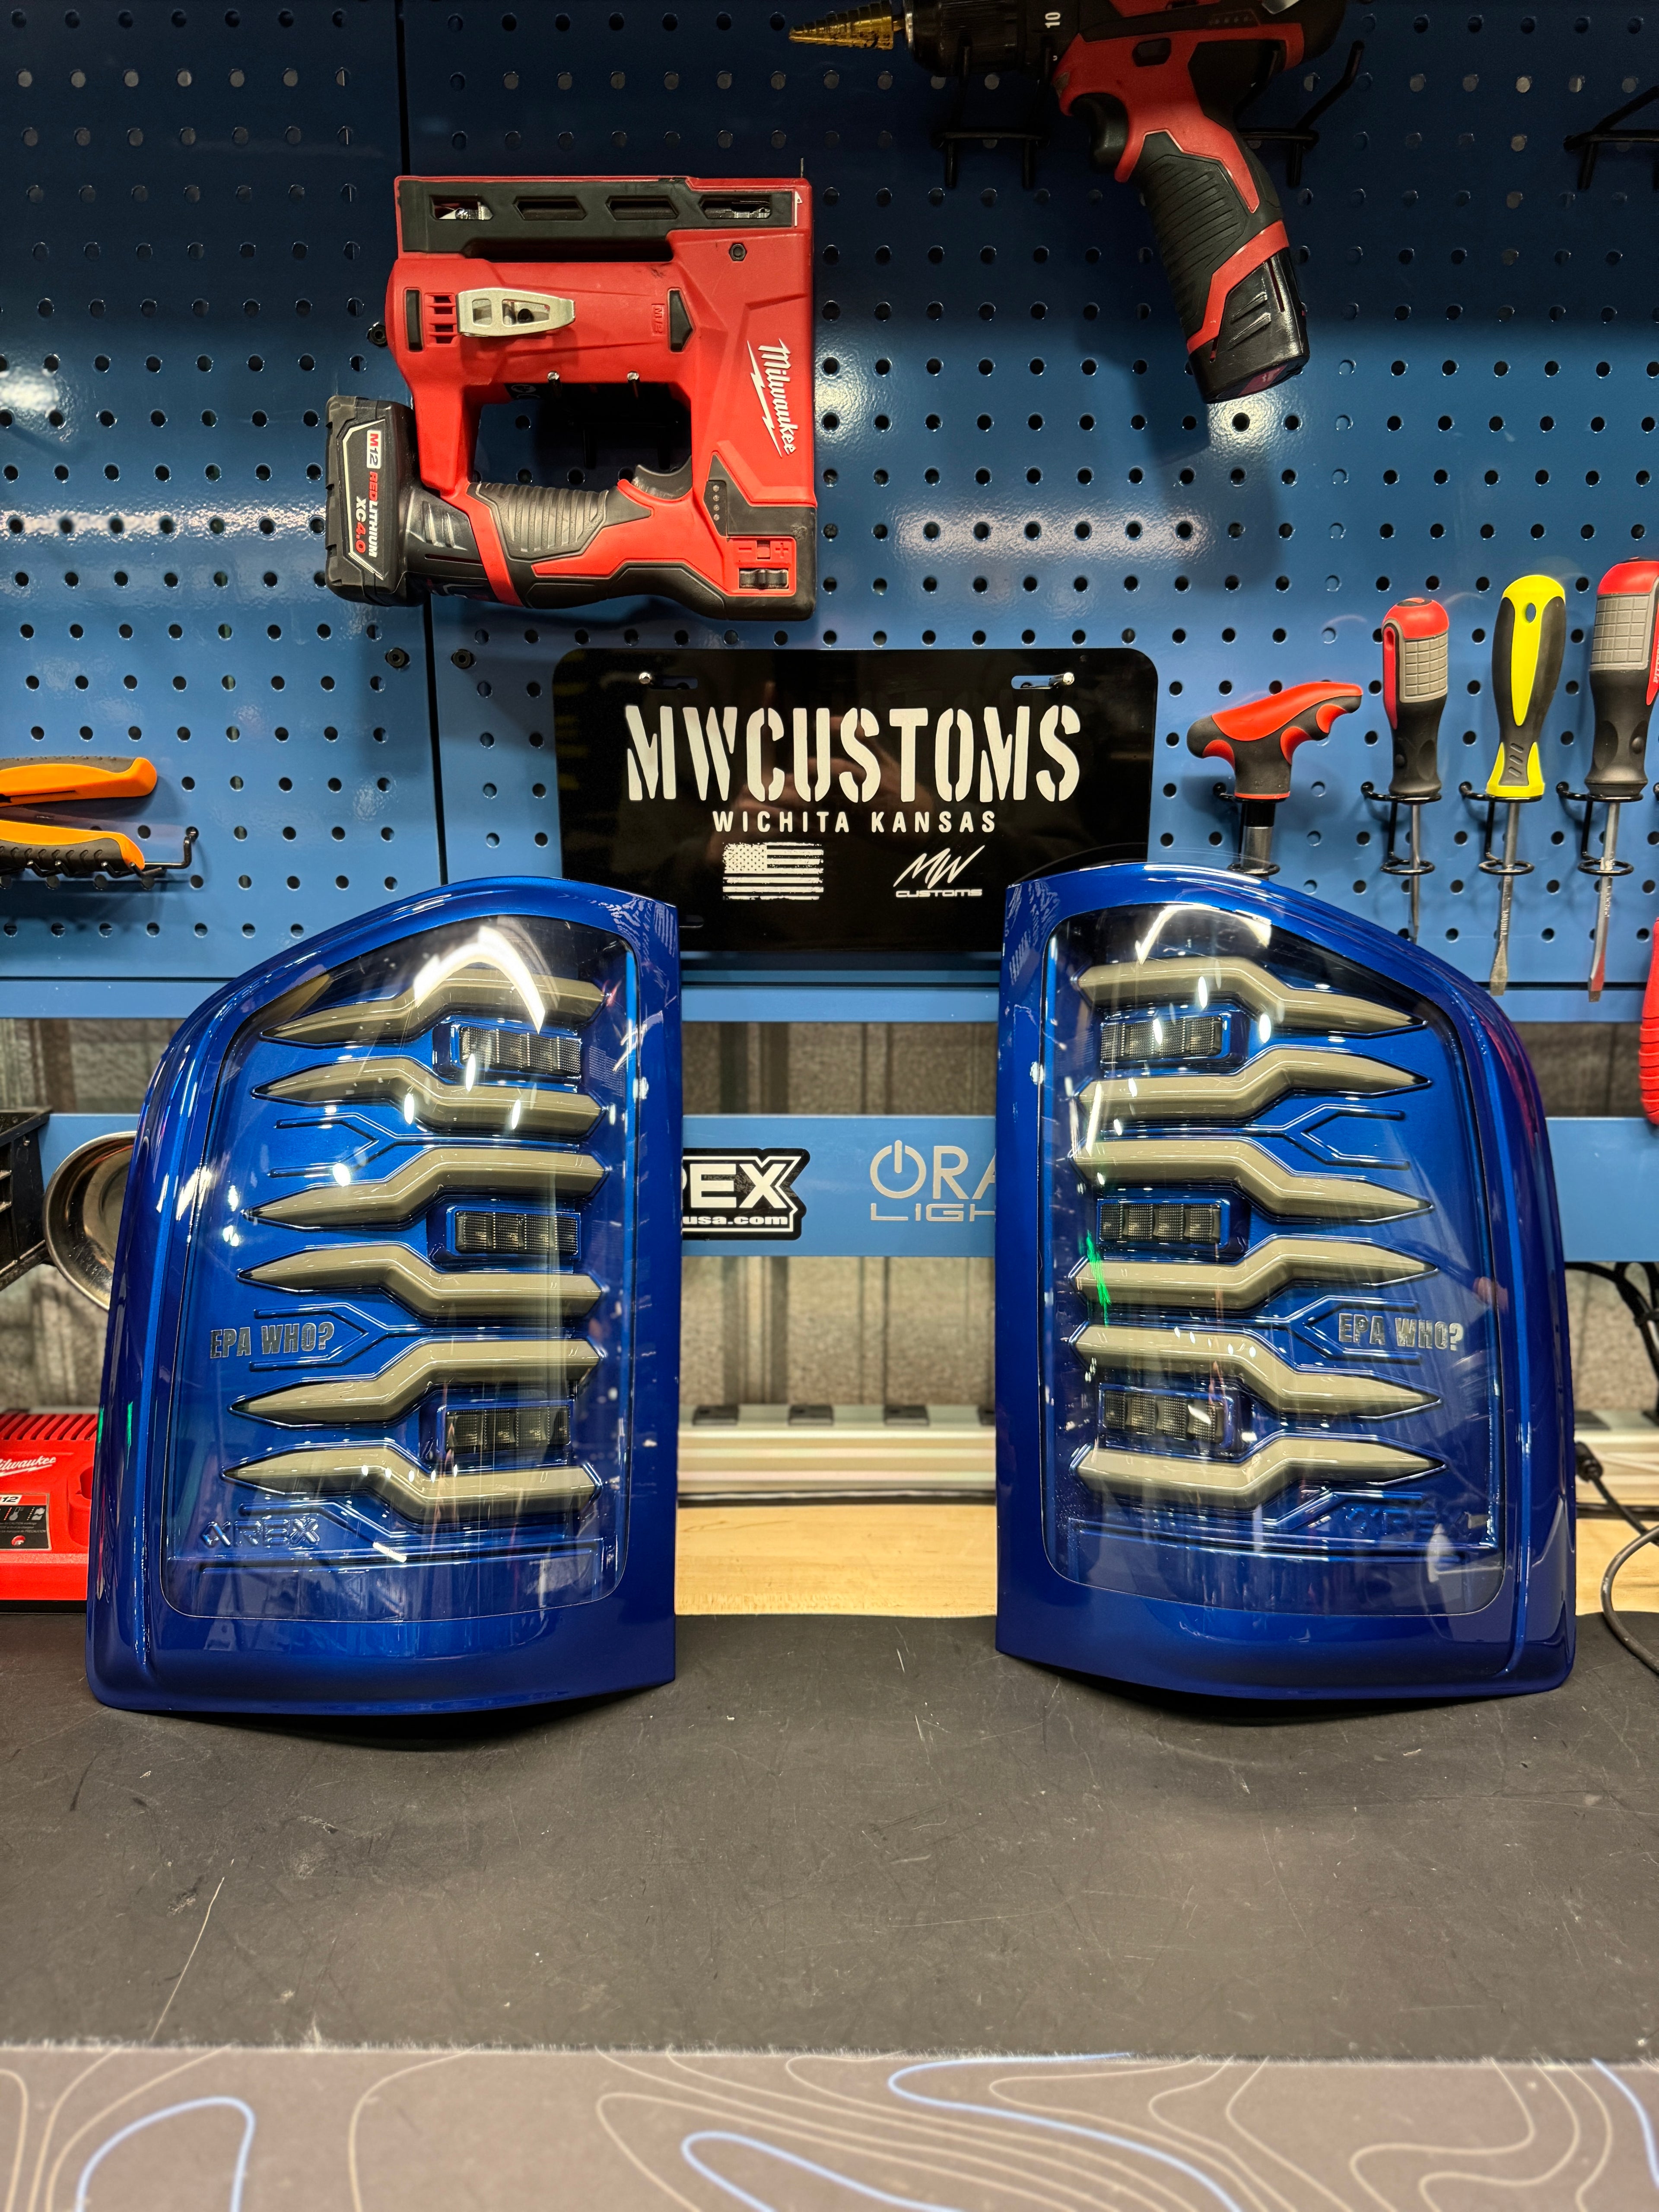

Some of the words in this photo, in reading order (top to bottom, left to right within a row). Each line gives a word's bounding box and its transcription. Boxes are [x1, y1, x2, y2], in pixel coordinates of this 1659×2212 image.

[1045, 12, 1061, 29] 10
[758, 338, 798, 455] Milwaukee
[370, 433, 379, 467] M12
[626, 705, 1080, 803] MWCUSTOMS
[713, 810, 849, 833] WICHITA
[871, 810, 996, 833] KANSAS
[893, 845, 985, 889] MW
[896, 889, 982, 898] CUSTOMS
[683, 1163, 788, 1208] EX
[210, 1323, 251, 1359] EPA
[261, 1321, 335, 1355] WHO?
[1338, 1313, 1384, 1345] EPA
[1395, 1317, 1464, 1351] WHO?
[0, 1456, 56, 1471] ilwaukee
